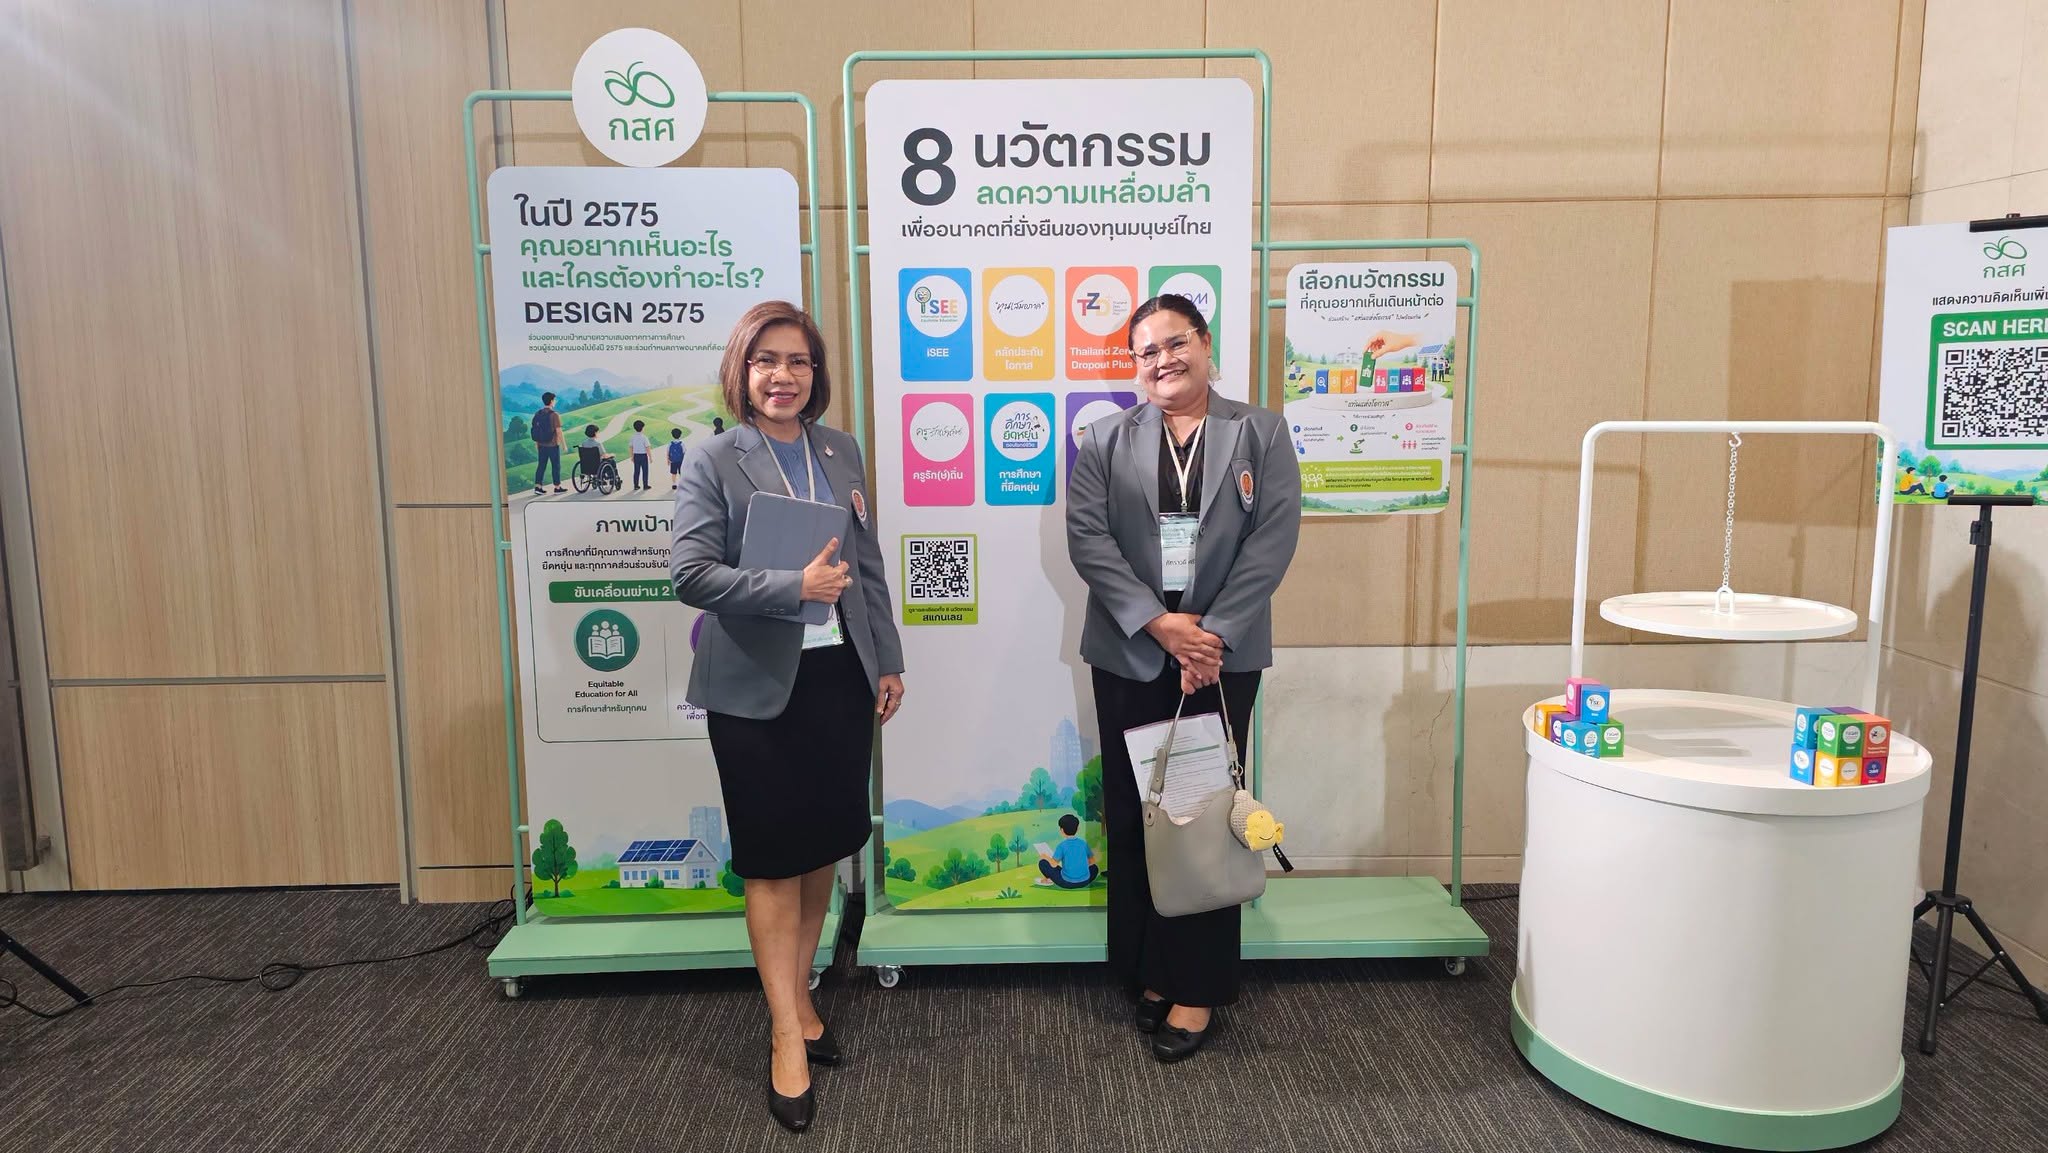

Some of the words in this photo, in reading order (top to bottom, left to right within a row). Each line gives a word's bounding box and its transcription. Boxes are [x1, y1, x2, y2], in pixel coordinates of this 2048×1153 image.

[608, 117, 676, 142] กสศ
[901, 127, 957, 206] 8
[974, 120, 1211, 168] นวัตกรรม
[976, 171, 1210, 205] ลดความเหลื่อมล้ำ
[513, 193, 572, 227] ในปี
[583, 202, 659, 227] 2575
[901, 215, 1212, 240] เพื่ออนาคตที่ยั่งยืนของทุนมนุษย์ไทย
[519, 230, 733, 264] คุณอยากเห็นอะไร
[521, 261, 765, 289] และใครต้องทำอะไร?
[1299, 268, 1445, 290] เลือกนวัตกรรม
[1983, 264, 2026, 279] กสศ
[1299, 293, 1444, 313] ที่คุณอยากเห็นเดินหน้าต่อ
[524, 302, 633, 324] DESIGN
[641, 302, 705, 324] 2575
[1943, 320, 1997, 337] SCAN
[926, 348, 949, 357] iSEE
[1070, 347, 1111, 356] Thailand
[1071, 360, 1110, 371] Dropout
[1112, 360, 1133, 369] Plus
[1005, 419, 1032, 430] ศึกษา
[1015, 412, 1031, 421] การ
[999, 468, 1042, 479] การศึกษา
[574, 582, 658, 598] ขับเคลื่อนผ่าน
[661, 586, 671, 597] 2
[922, 614, 963, 622] สแกนเลย
[588, 680, 625, 689] Equitable
[567, 704, 647, 715] การศึกษาสำหรับทุกคน
